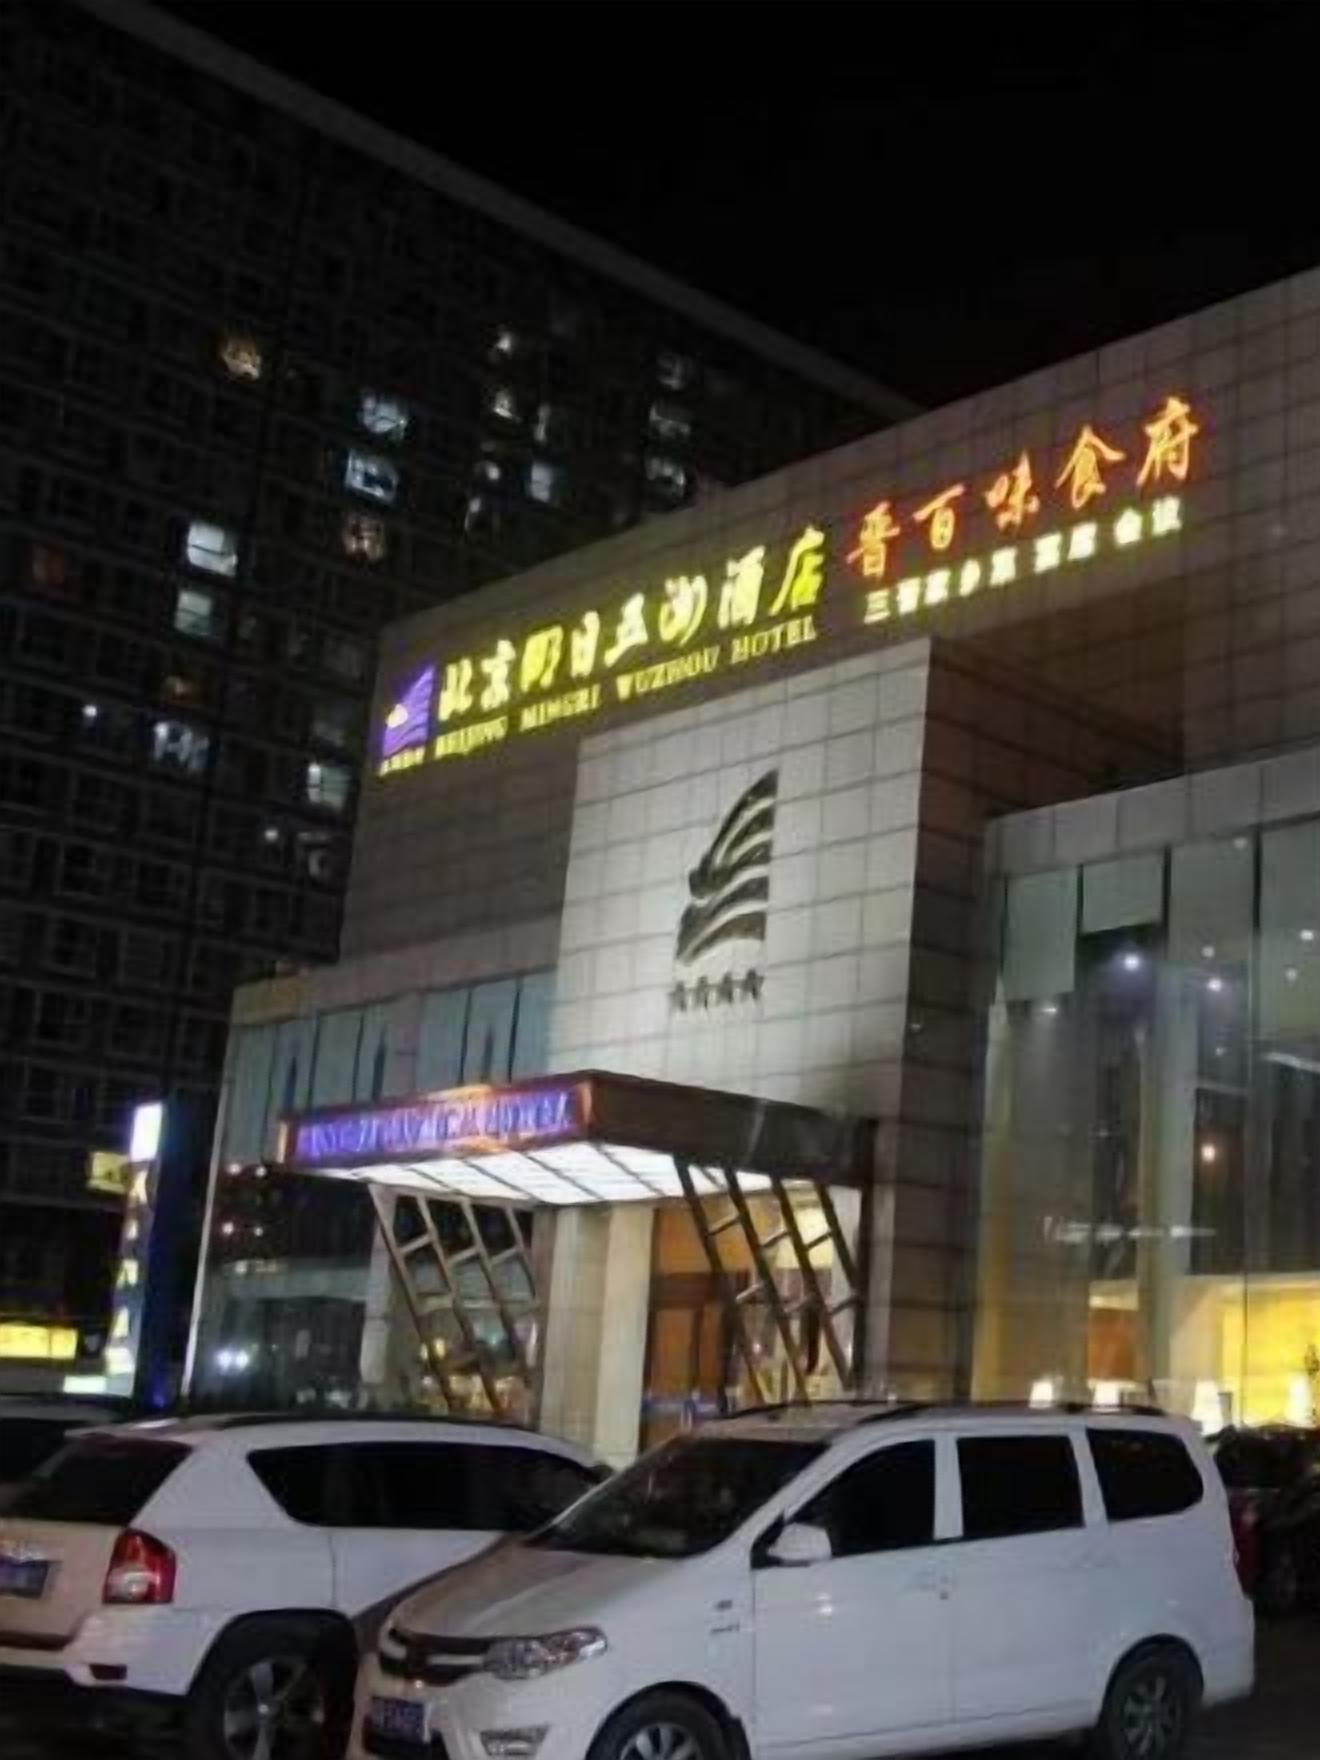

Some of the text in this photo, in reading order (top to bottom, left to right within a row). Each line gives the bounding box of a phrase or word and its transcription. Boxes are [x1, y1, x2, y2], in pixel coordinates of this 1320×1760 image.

[846, 396, 1199, 578] 晋百味食府
[730, 614, 817, 665] HOTEL
